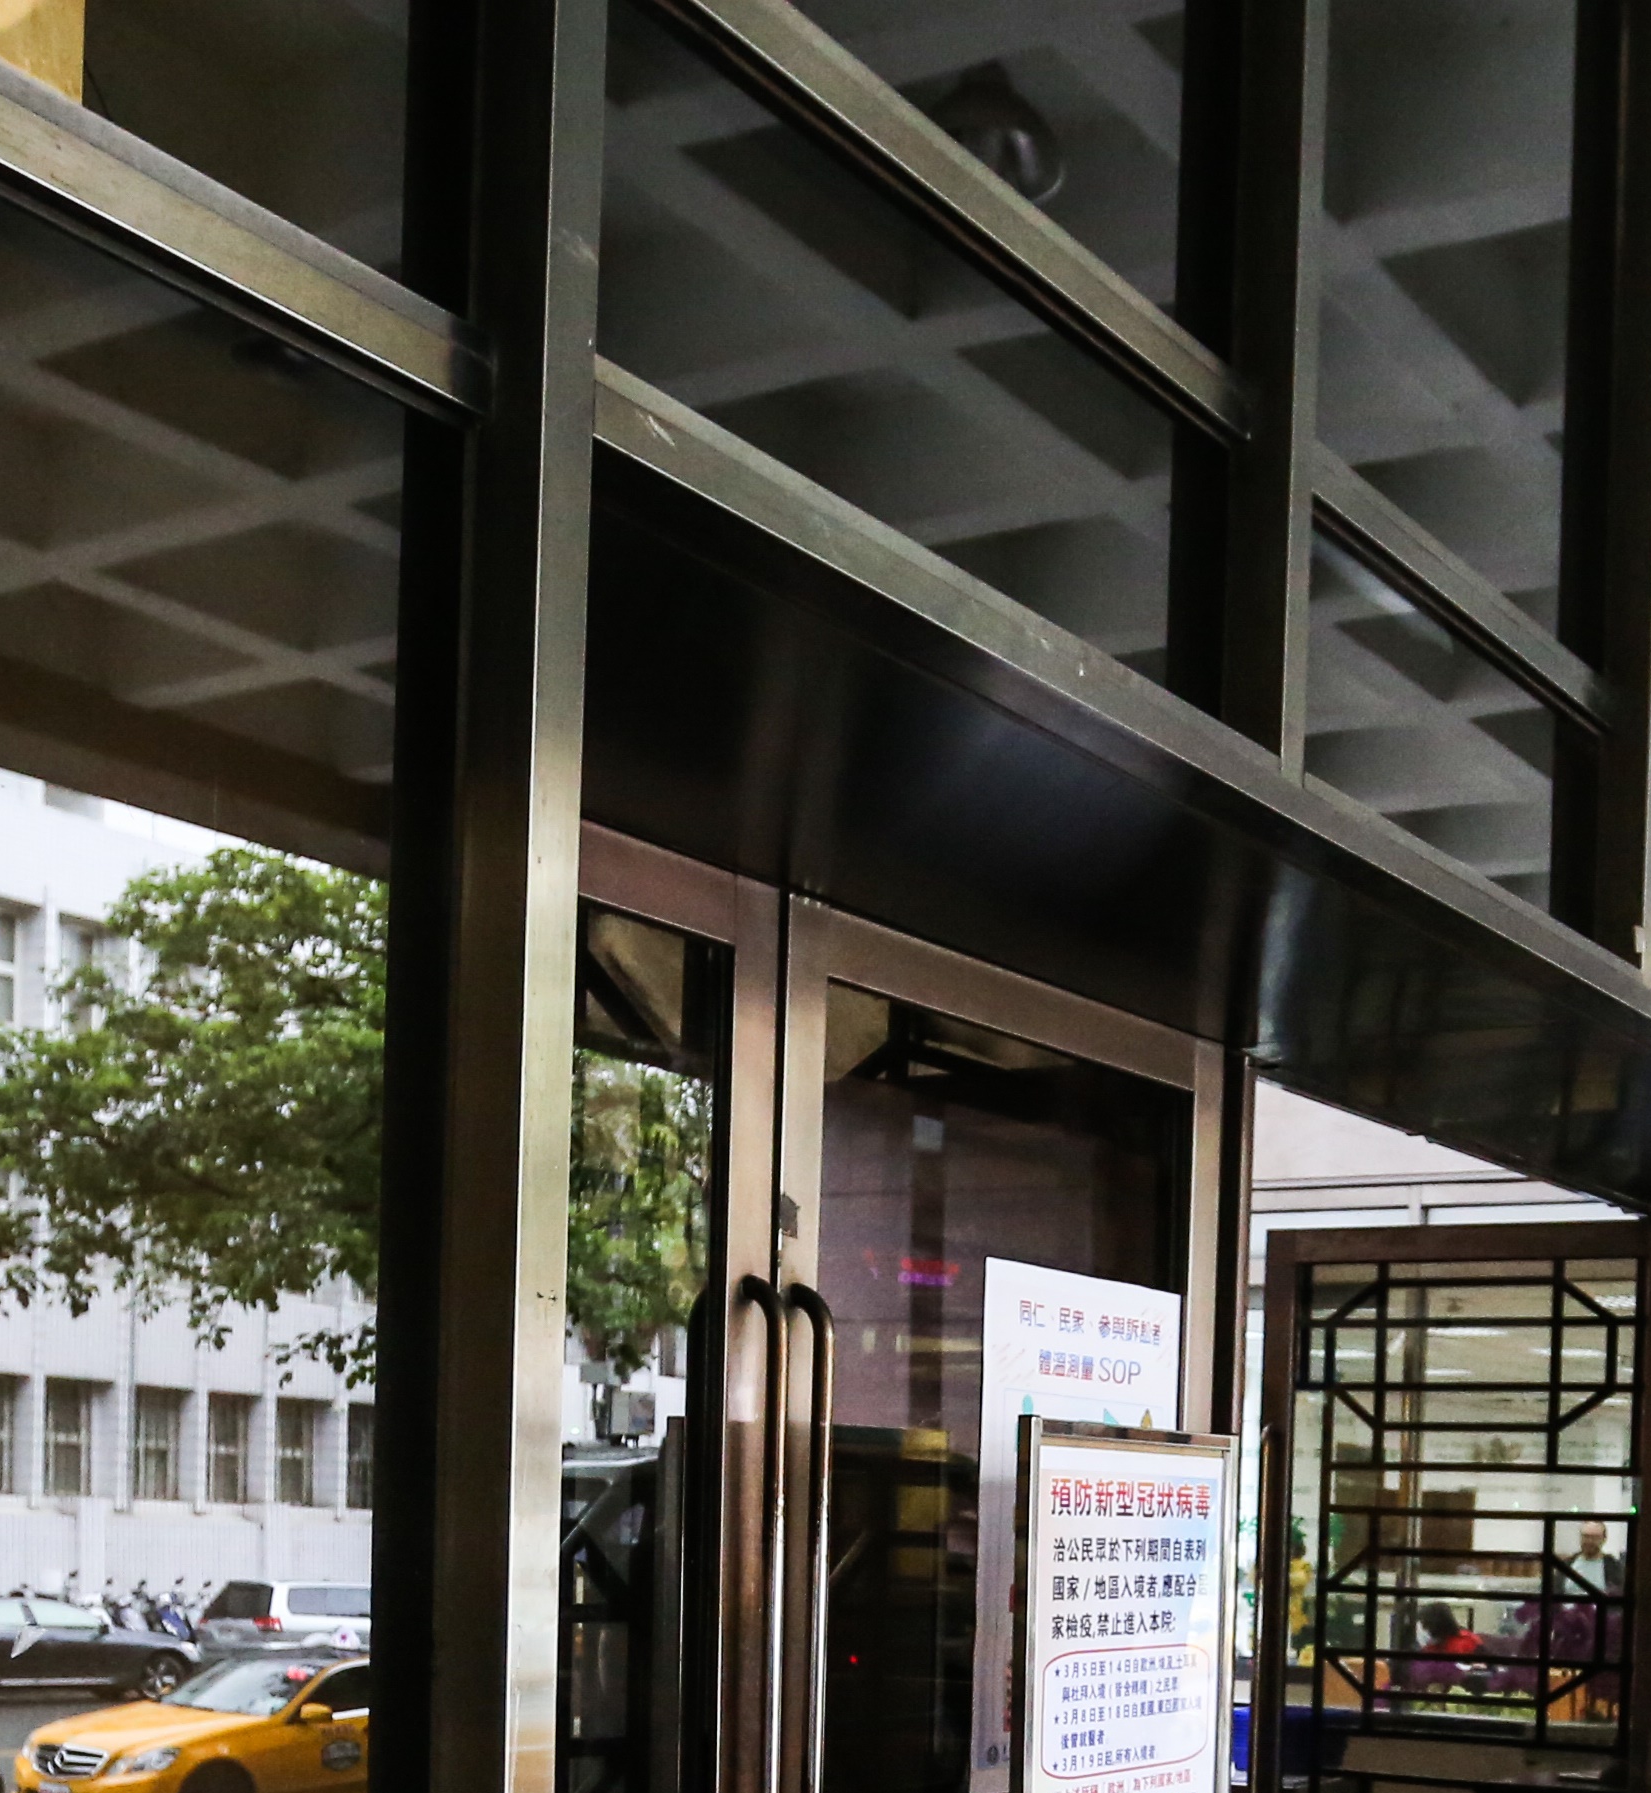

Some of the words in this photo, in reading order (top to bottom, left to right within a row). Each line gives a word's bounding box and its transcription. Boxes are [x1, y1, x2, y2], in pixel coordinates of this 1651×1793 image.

[1098, 1356, 1141, 1385] SOP
[1051, 1477, 1211, 1520] 預防新型冠狀病毒
